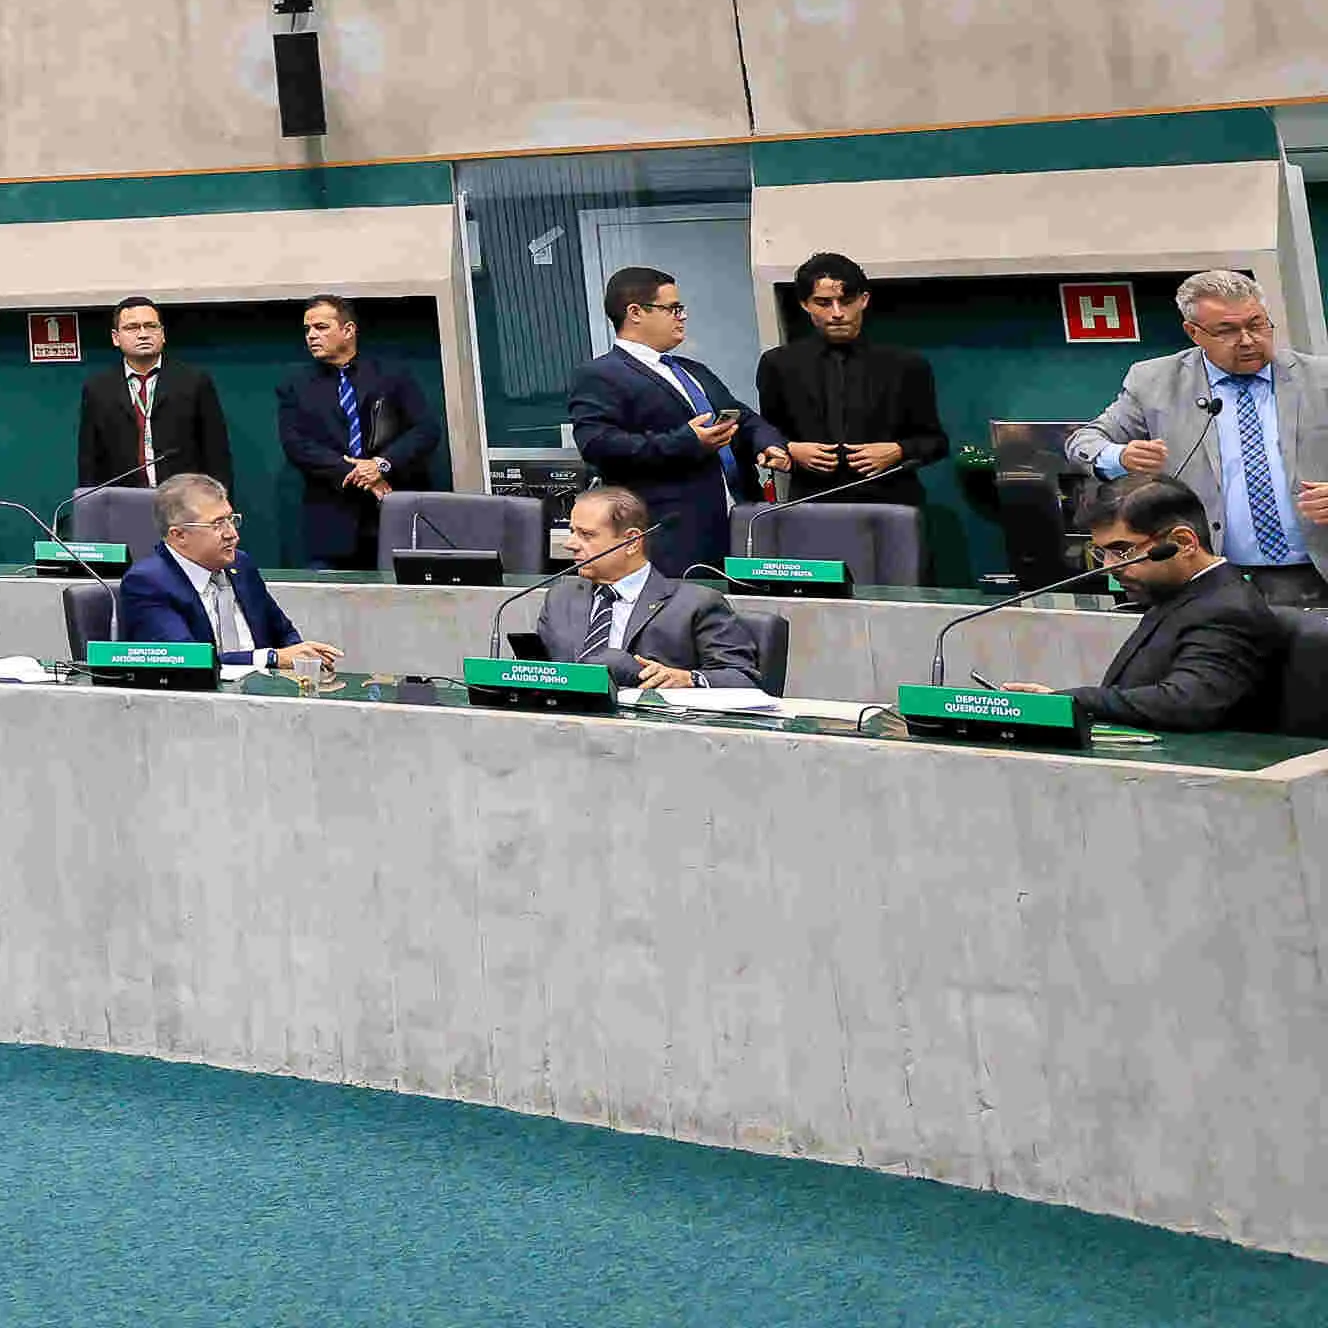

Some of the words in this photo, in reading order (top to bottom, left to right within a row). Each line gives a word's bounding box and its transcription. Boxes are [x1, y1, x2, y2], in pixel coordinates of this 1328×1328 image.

[1079, 295, 1120, 329] H
[511, 665, 558, 675] DEPUTADO
[955, 695, 1009, 706] DEPUTADO
[944, 703, 989, 715] QUEIROZ
[991, 706, 1021, 717] FILHO
